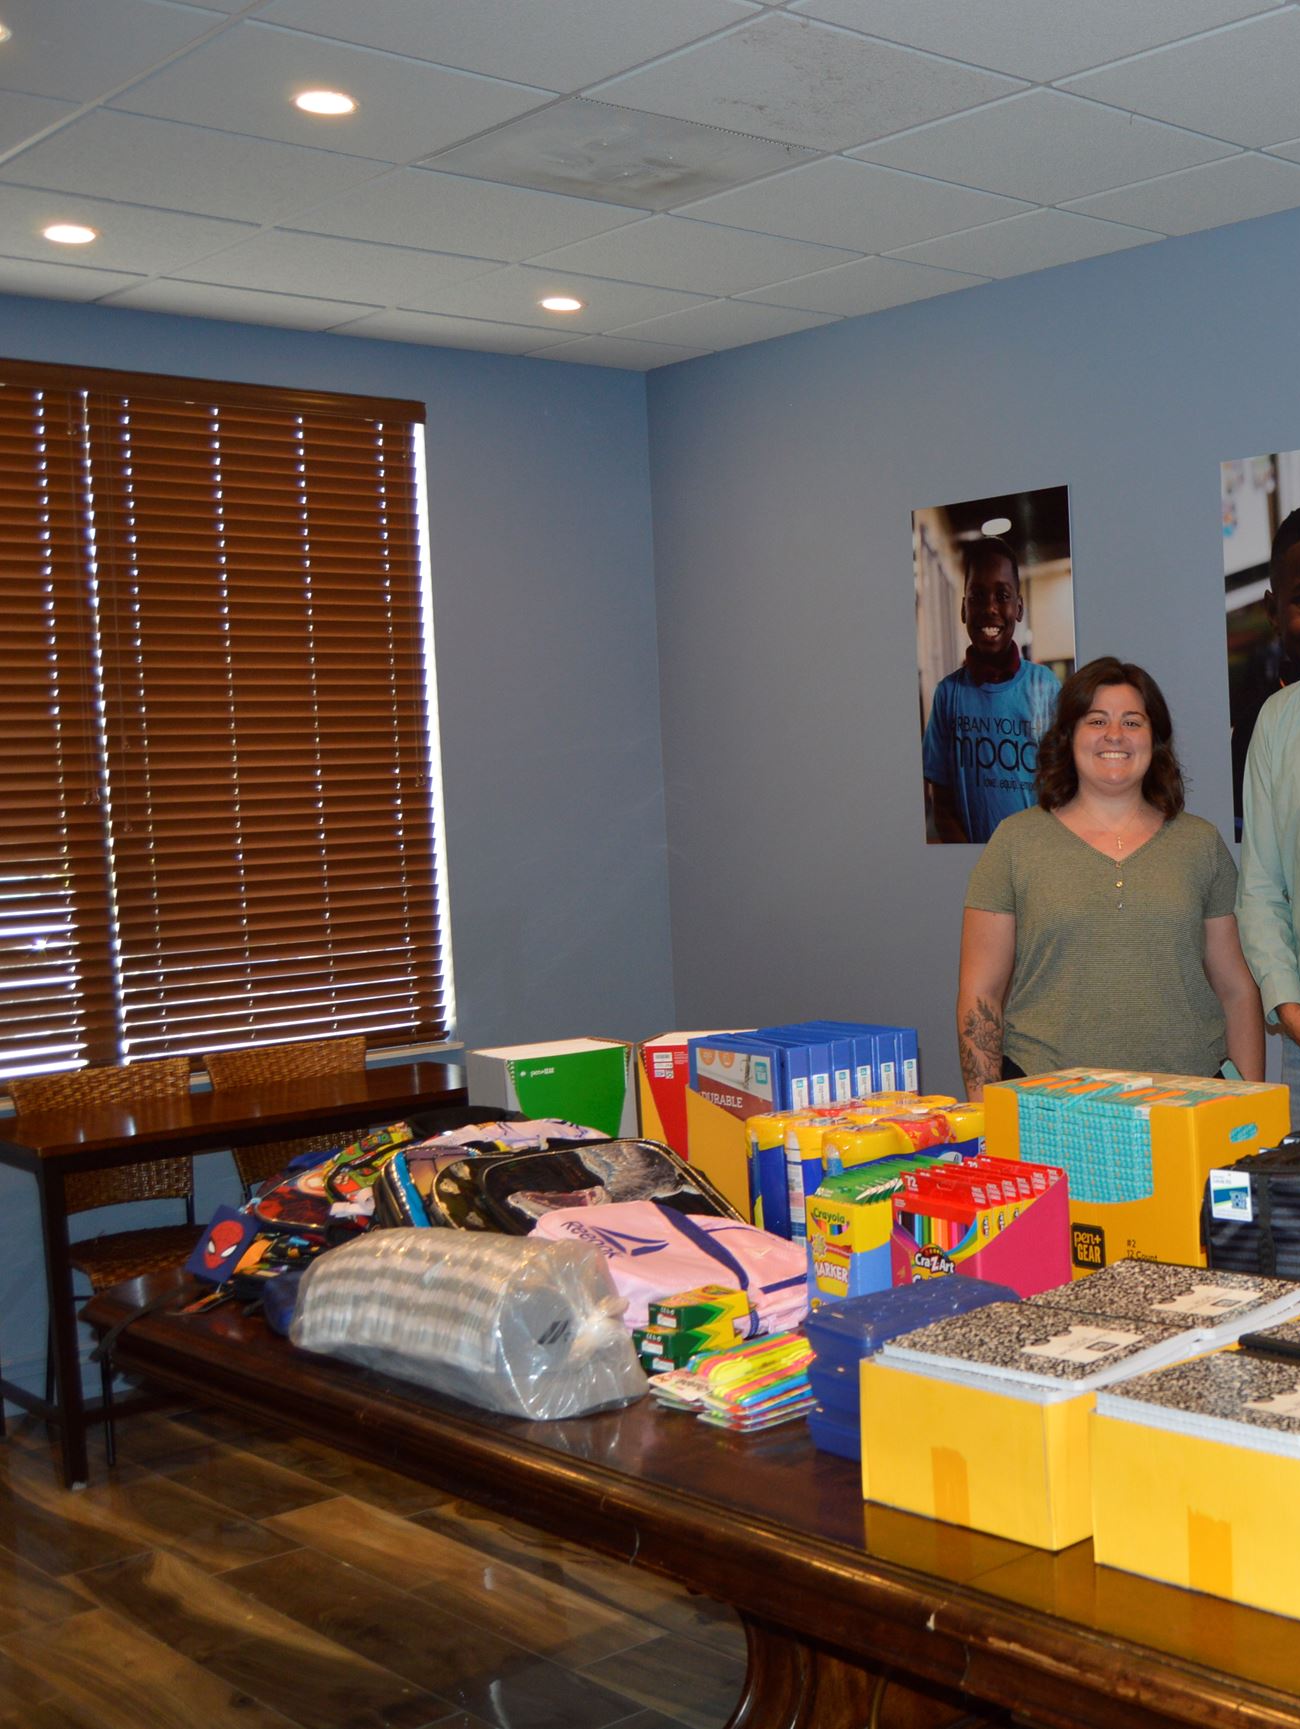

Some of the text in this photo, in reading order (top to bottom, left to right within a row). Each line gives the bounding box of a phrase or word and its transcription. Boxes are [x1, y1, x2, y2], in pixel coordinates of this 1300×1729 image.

[955, 715, 990, 734] RBAN
[953, 736, 1041, 787] mpac
[701, 1091, 743, 1108] DURABLE
[904, 1174, 918, 1188] 72
[813, 1208, 845, 1224] Crayola
[1073, 1231, 1102, 1247] pen+
[1126, 1239, 1136, 1249] #2
[1077, 1243, 1101, 1263] GEAR
[814, 1261, 849, 1283] MARKER
